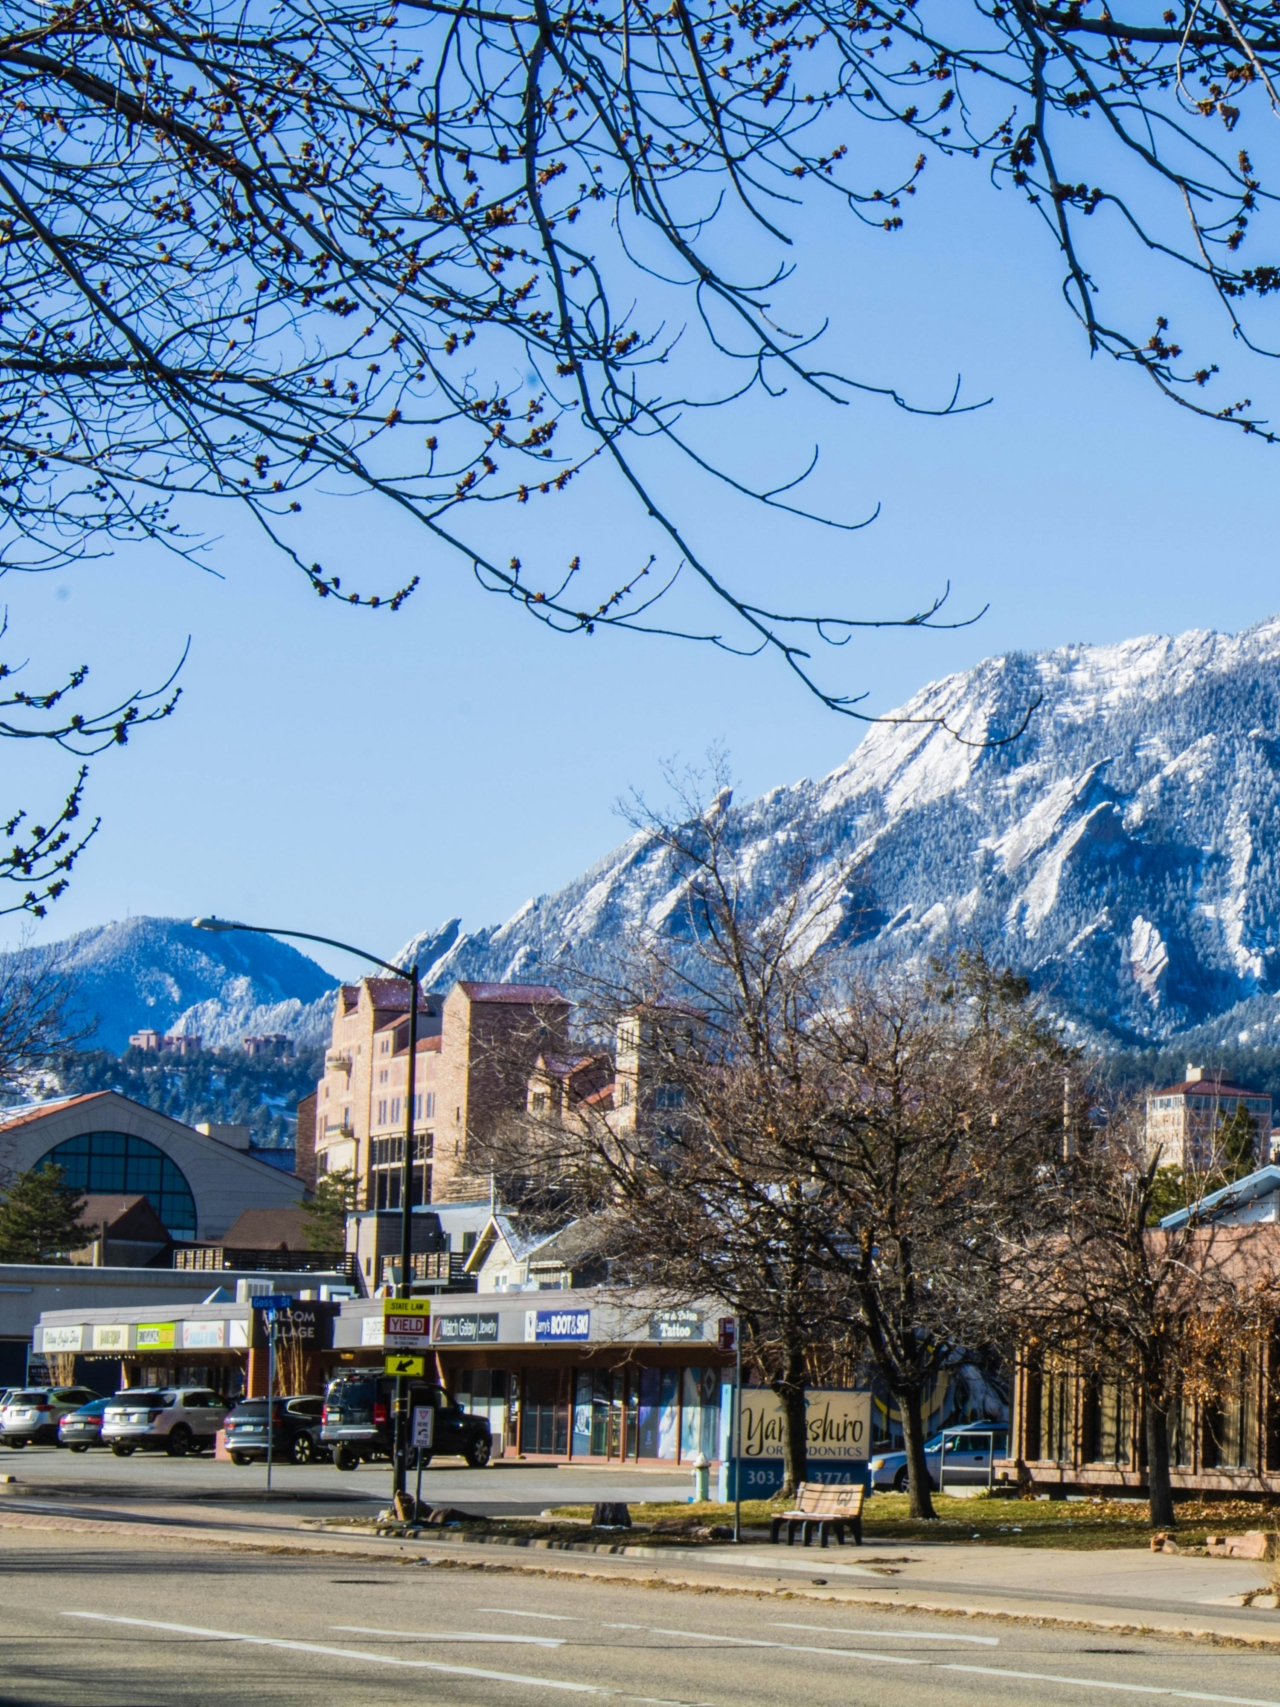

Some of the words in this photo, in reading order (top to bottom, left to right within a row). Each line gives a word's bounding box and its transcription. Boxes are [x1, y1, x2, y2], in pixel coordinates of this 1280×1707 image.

[253, 1297, 274, 1308] Goss
[281, 1297, 291, 1307] St
[390, 1302, 409, 1311] STATE
[410, 1302, 424, 1311] LAW
[392, 1318, 423, 1332] YIELD
[660, 1323, 691, 1337] Tattoo
[263, 1326, 315, 1338] VLLAGE
[741, 1401, 864, 1457] Yashiro
[765, 1445, 863, 1457] ORDONTICS
[747, 1470, 852, 1485] 303..3774
